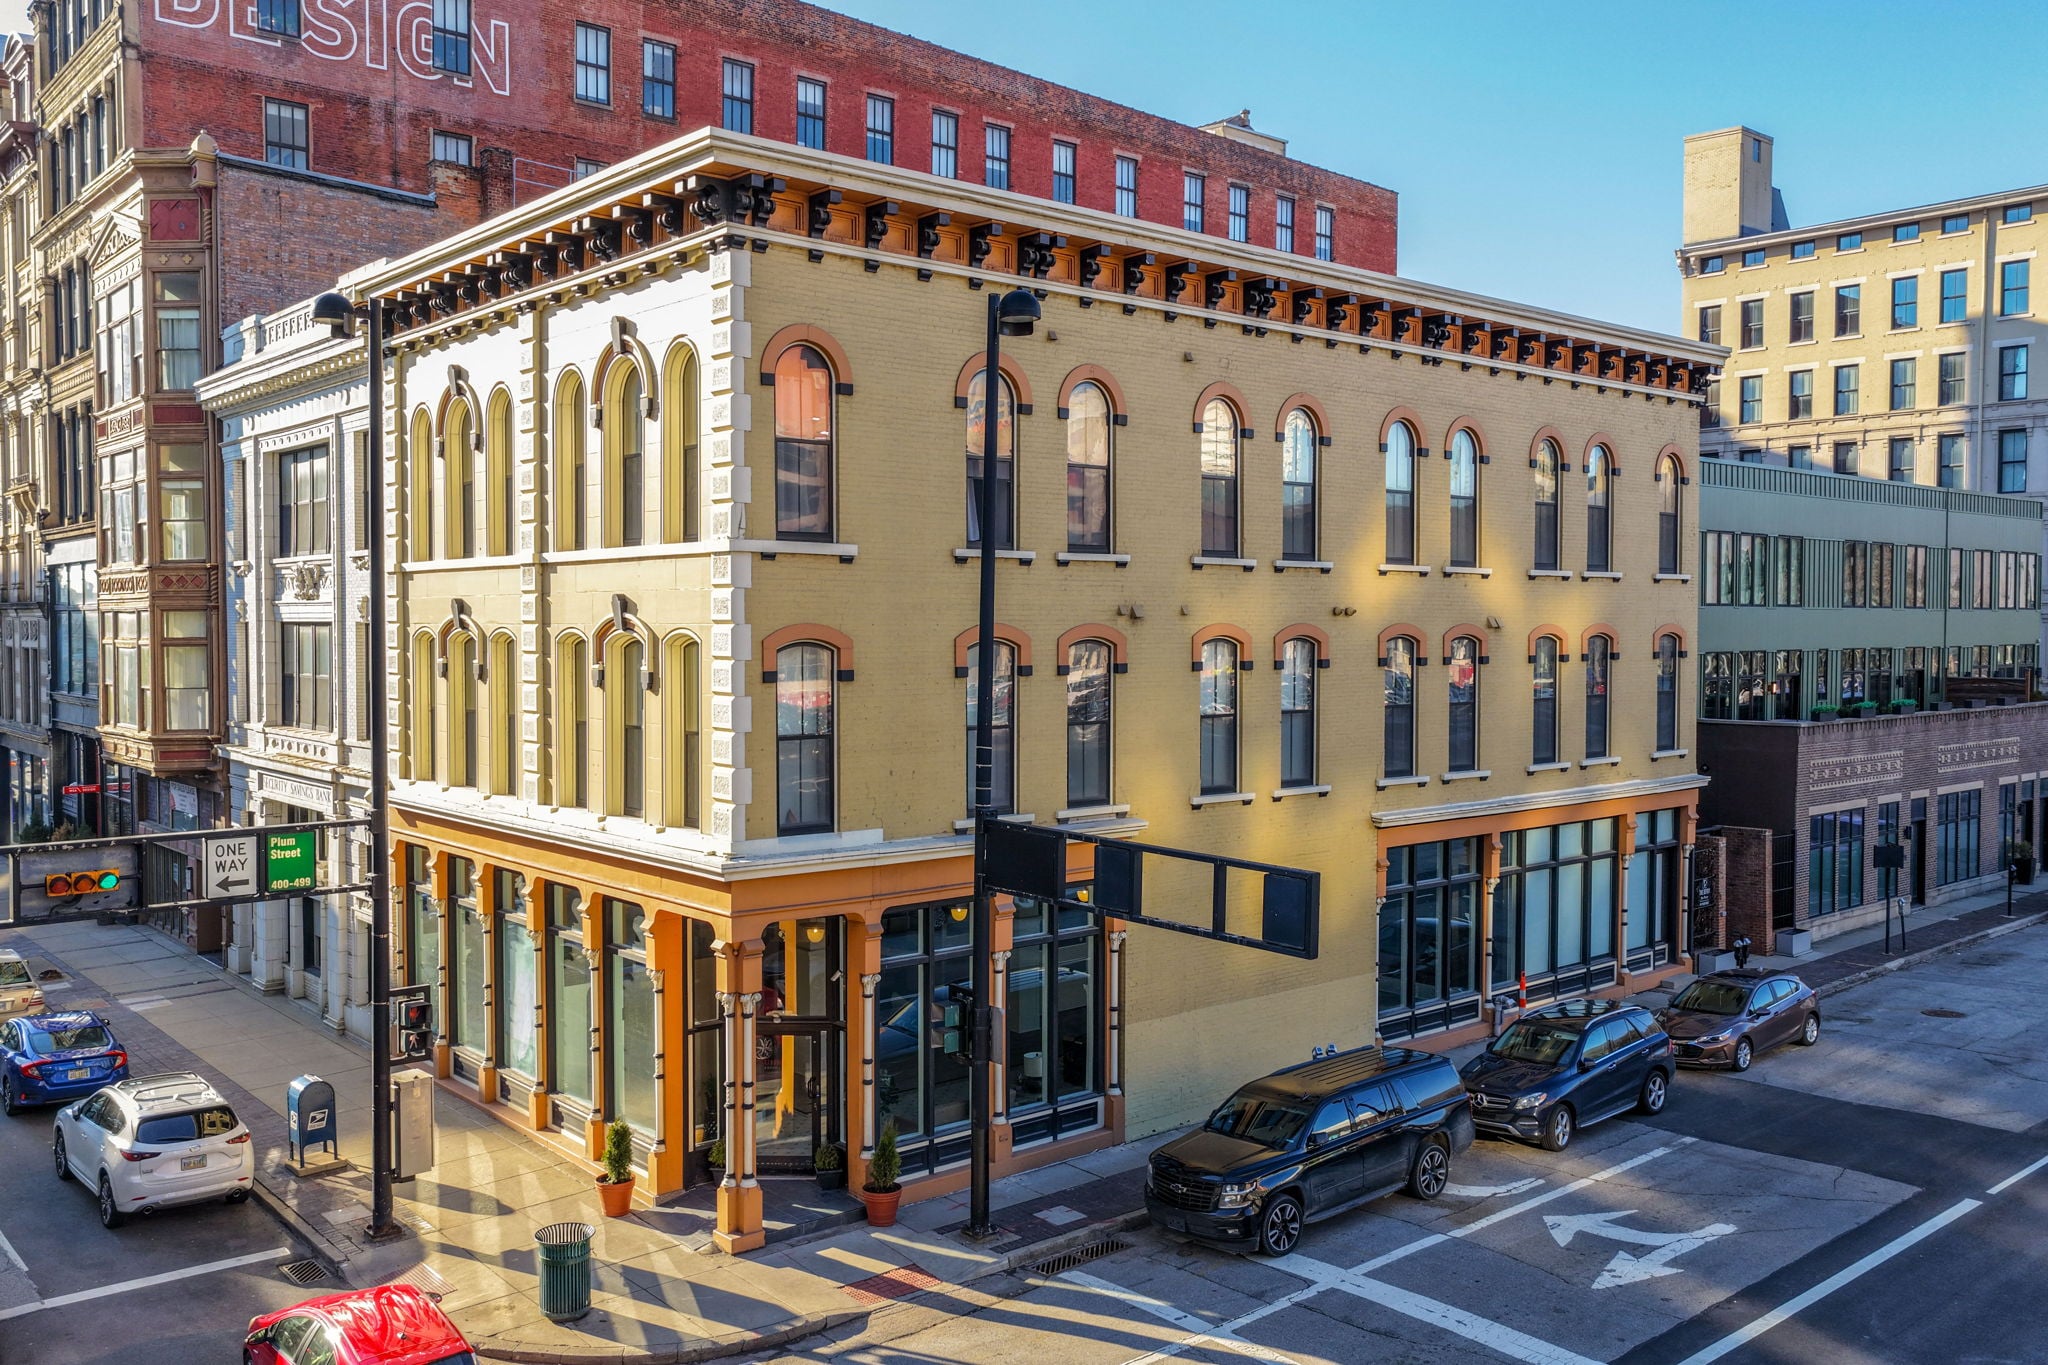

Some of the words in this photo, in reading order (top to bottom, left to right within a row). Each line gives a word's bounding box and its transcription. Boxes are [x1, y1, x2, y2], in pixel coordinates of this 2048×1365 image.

[264, 777, 288, 792] SECURITY
[290, 783, 314, 799] SAVINGS
[315, 788, 331, 803] BANK
[270, 837, 295, 848] Plum
[215, 842, 247, 858] ONE
[270, 848, 302, 860] Street
[215, 858, 248, 873] WAY
[271, 877, 312, 890] 400-499
